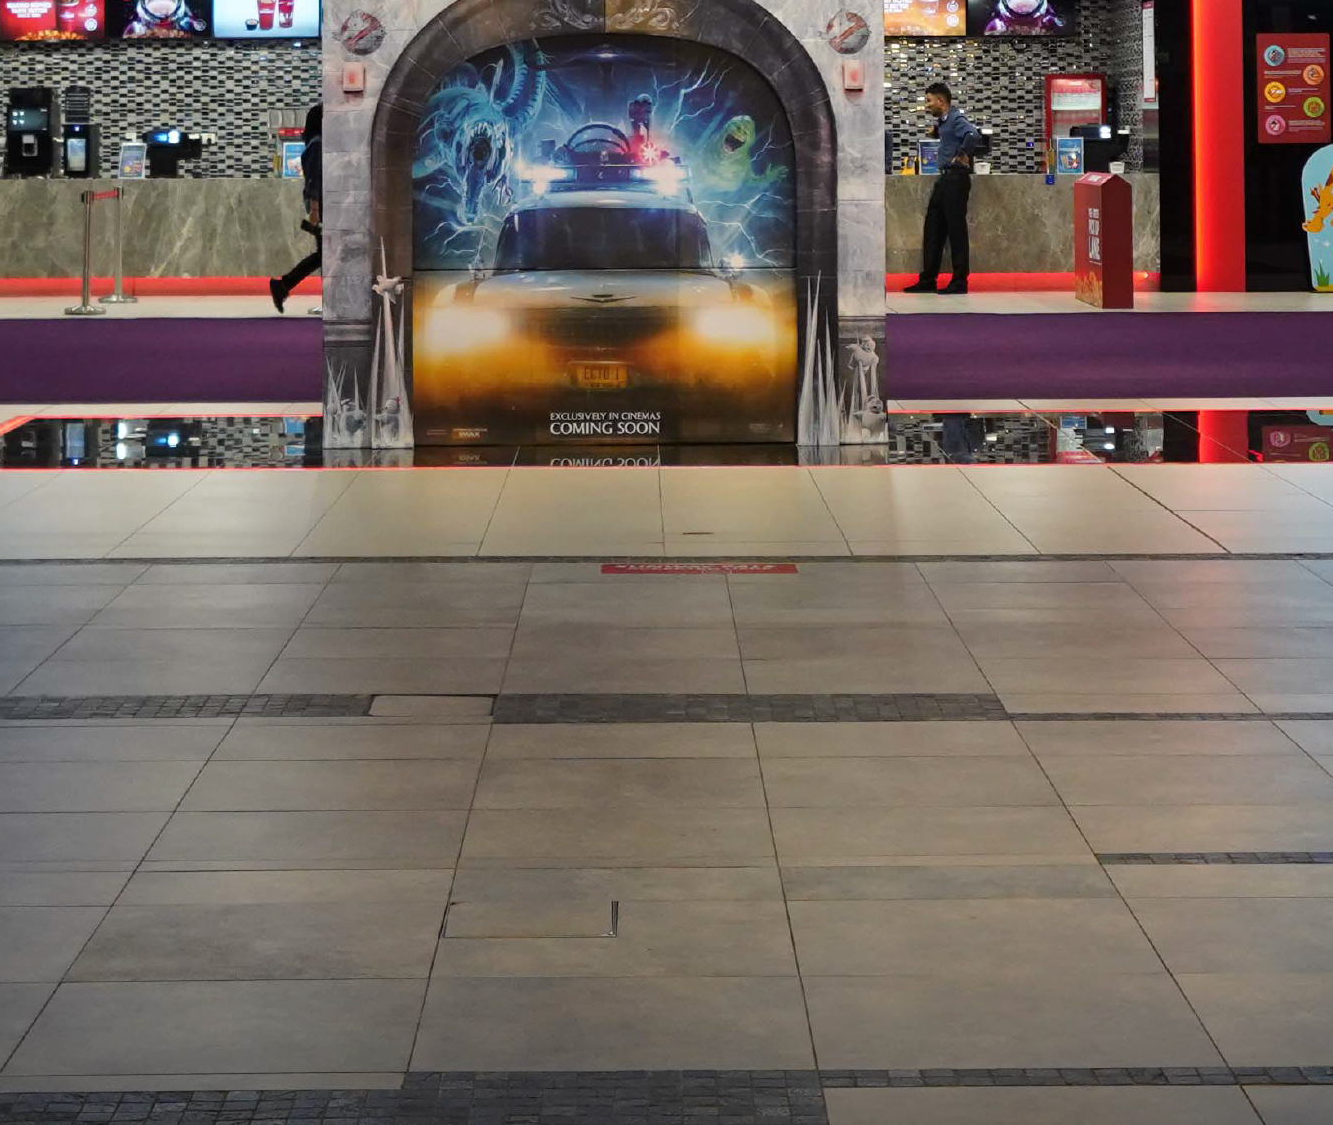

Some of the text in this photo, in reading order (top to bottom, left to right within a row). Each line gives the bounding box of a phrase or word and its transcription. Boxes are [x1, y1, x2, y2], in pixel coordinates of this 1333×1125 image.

[550, 411, 661, 421] EXCLUSIVELY IN CINEMAS
[550, 422, 660, 436] COMING SOON
